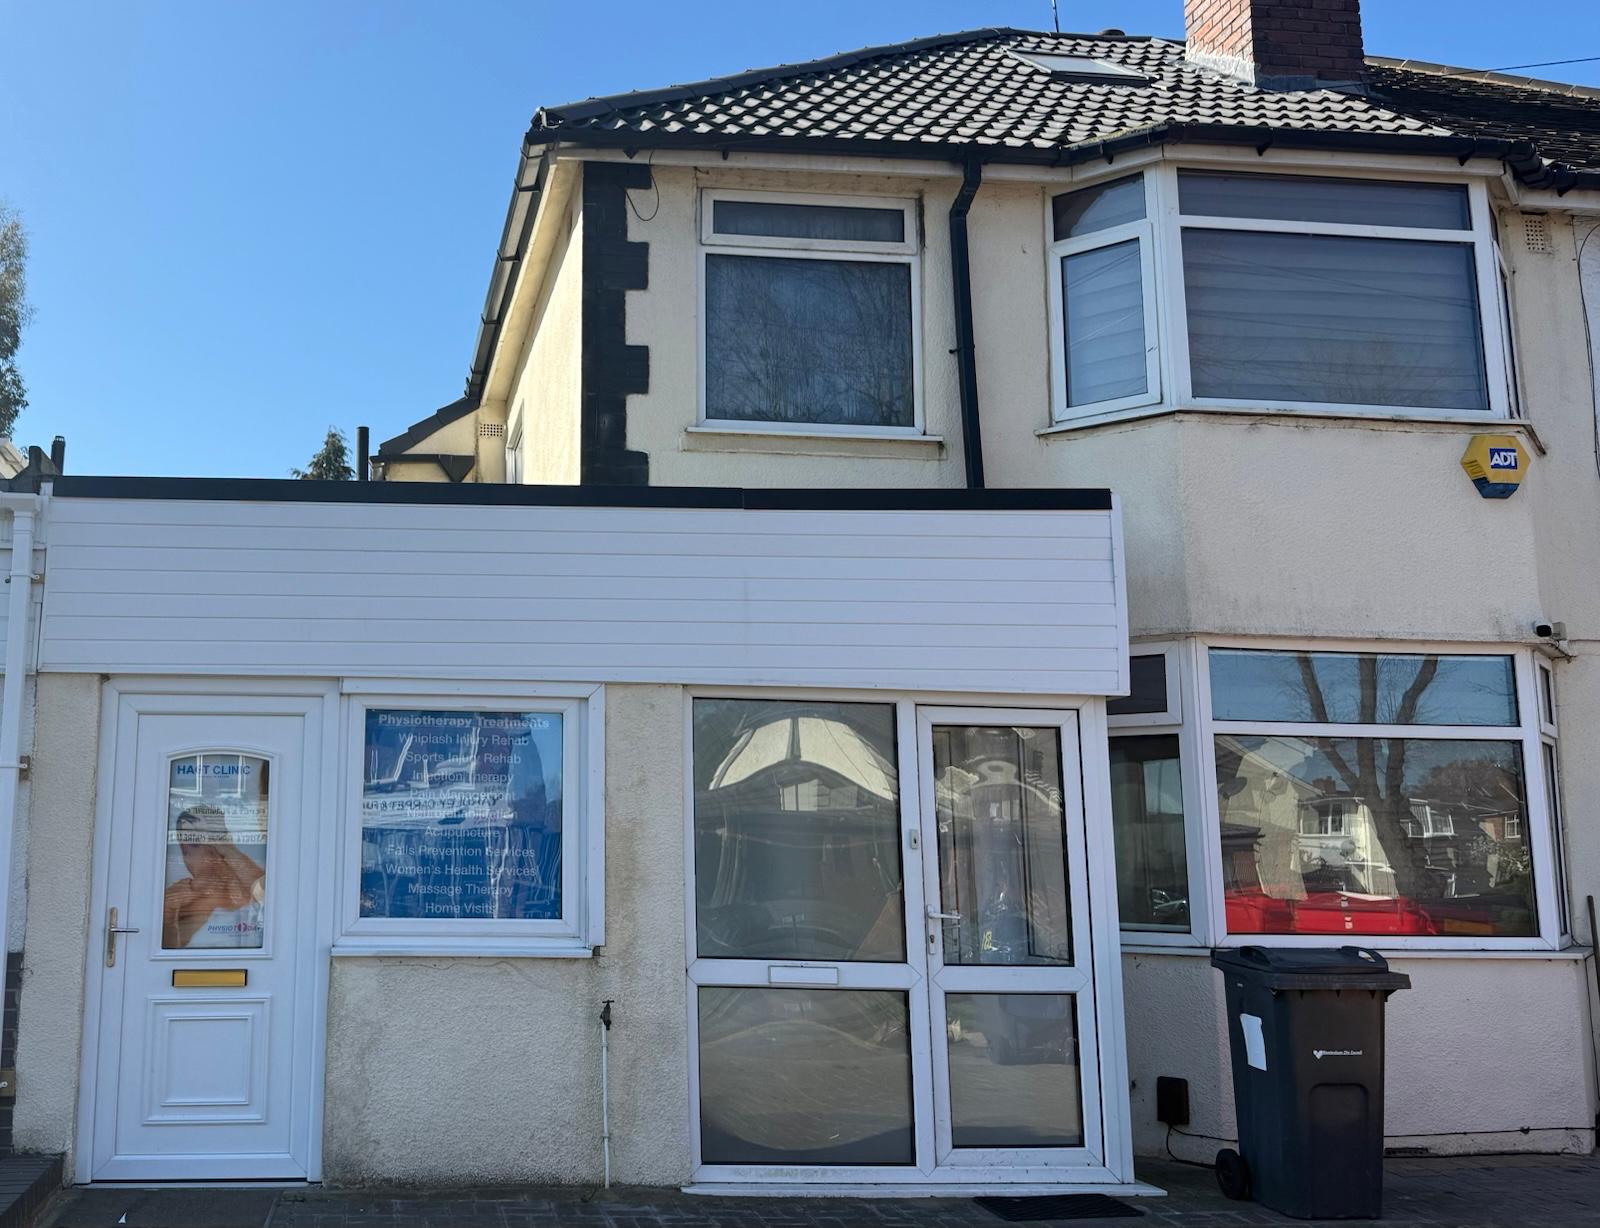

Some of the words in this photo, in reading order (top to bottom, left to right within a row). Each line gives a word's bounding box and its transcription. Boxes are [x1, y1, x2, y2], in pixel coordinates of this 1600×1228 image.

[1490, 452, 1517, 466] ADT
[378, 714, 472, 728] Physiotherapy
[477, 716, 550, 729] Treatments
[399, 733, 453, 745] Whiplash
[491, 734, 529, 746] Rehab
[405, 751, 444, 764] Sports
[484, 752, 522, 764] Rehab
[410, 789, 437, 800] Pain
[386, 844, 415, 856] Falls
[418, 845, 482, 858] Prevention
[385, 863, 441, 875] Women's
[445, 863, 483, 875] Health
[408, 882, 462, 897] Massage
[425, 902, 460, 914] Home
[463, 903, 496, 915] Visits
